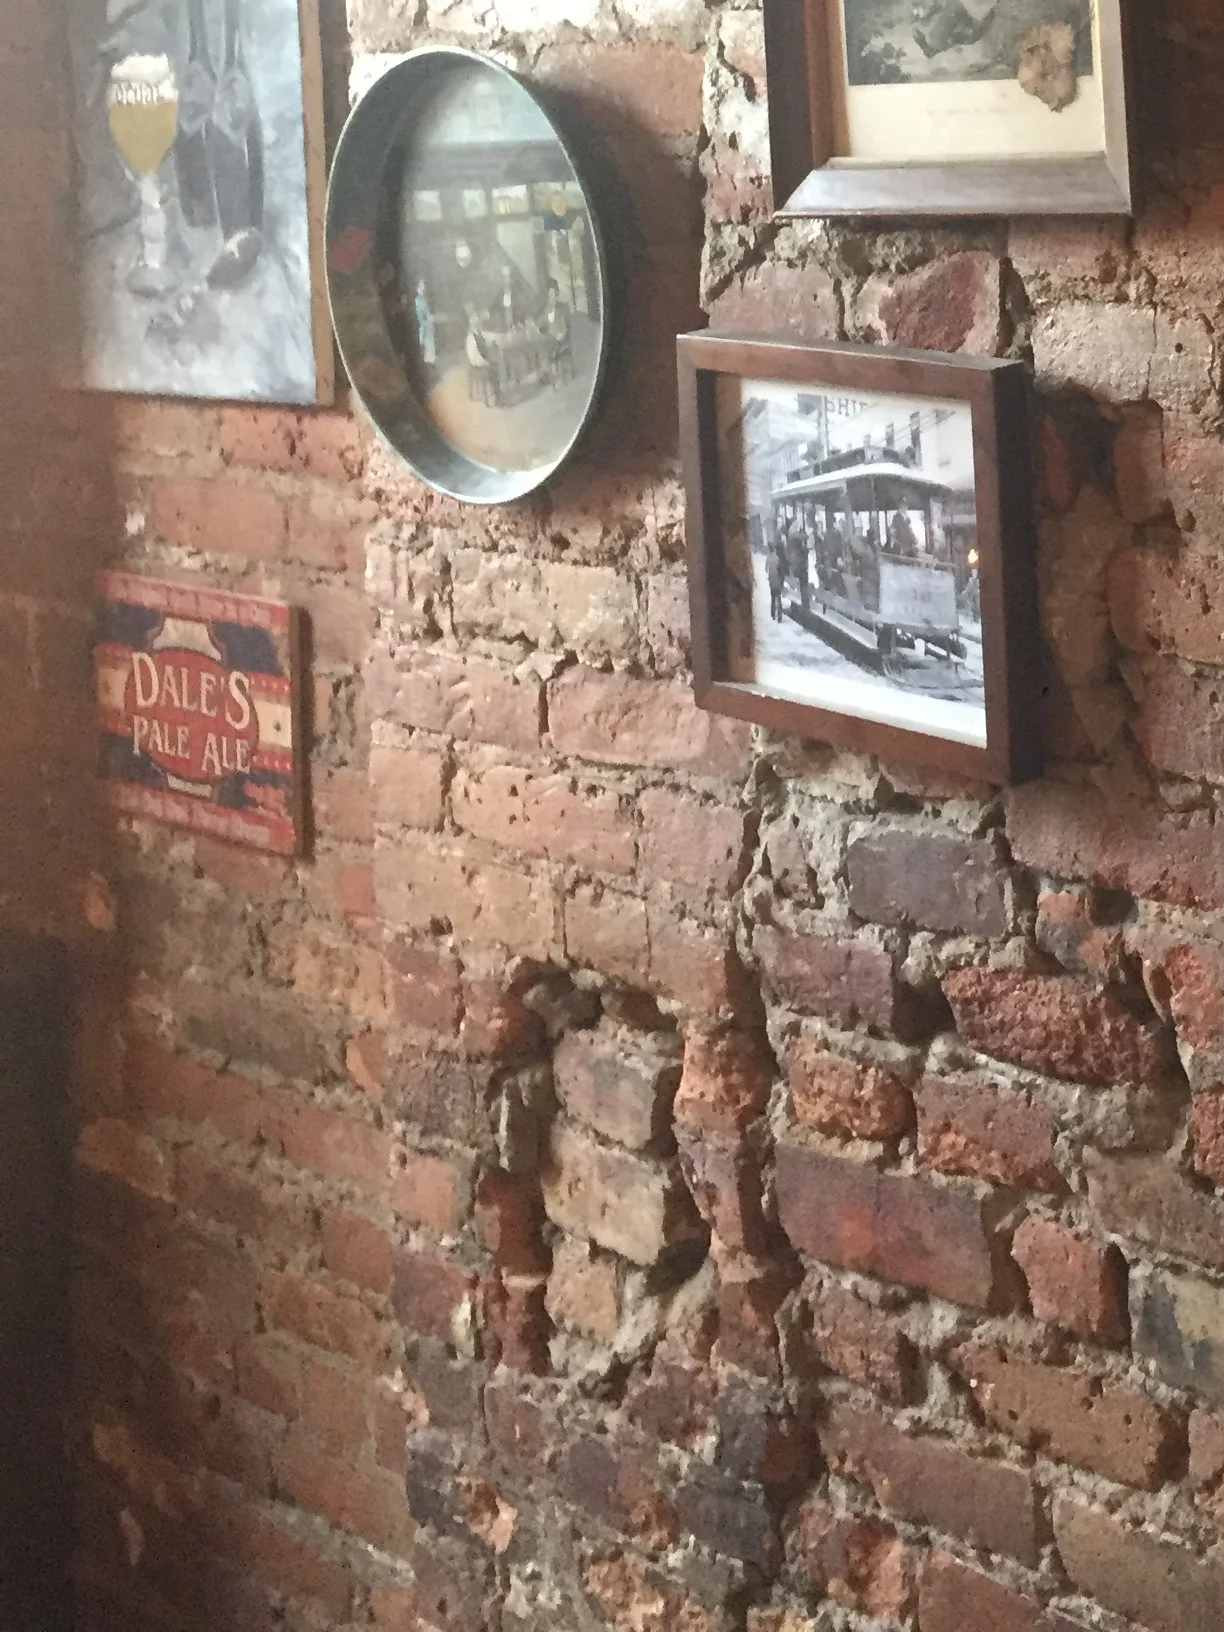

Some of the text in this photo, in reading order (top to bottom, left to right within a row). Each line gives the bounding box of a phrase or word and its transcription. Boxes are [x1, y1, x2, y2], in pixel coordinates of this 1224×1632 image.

[131, 651, 252, 731] DALE'S
[133, 715, 250, 776] PALE ALE
